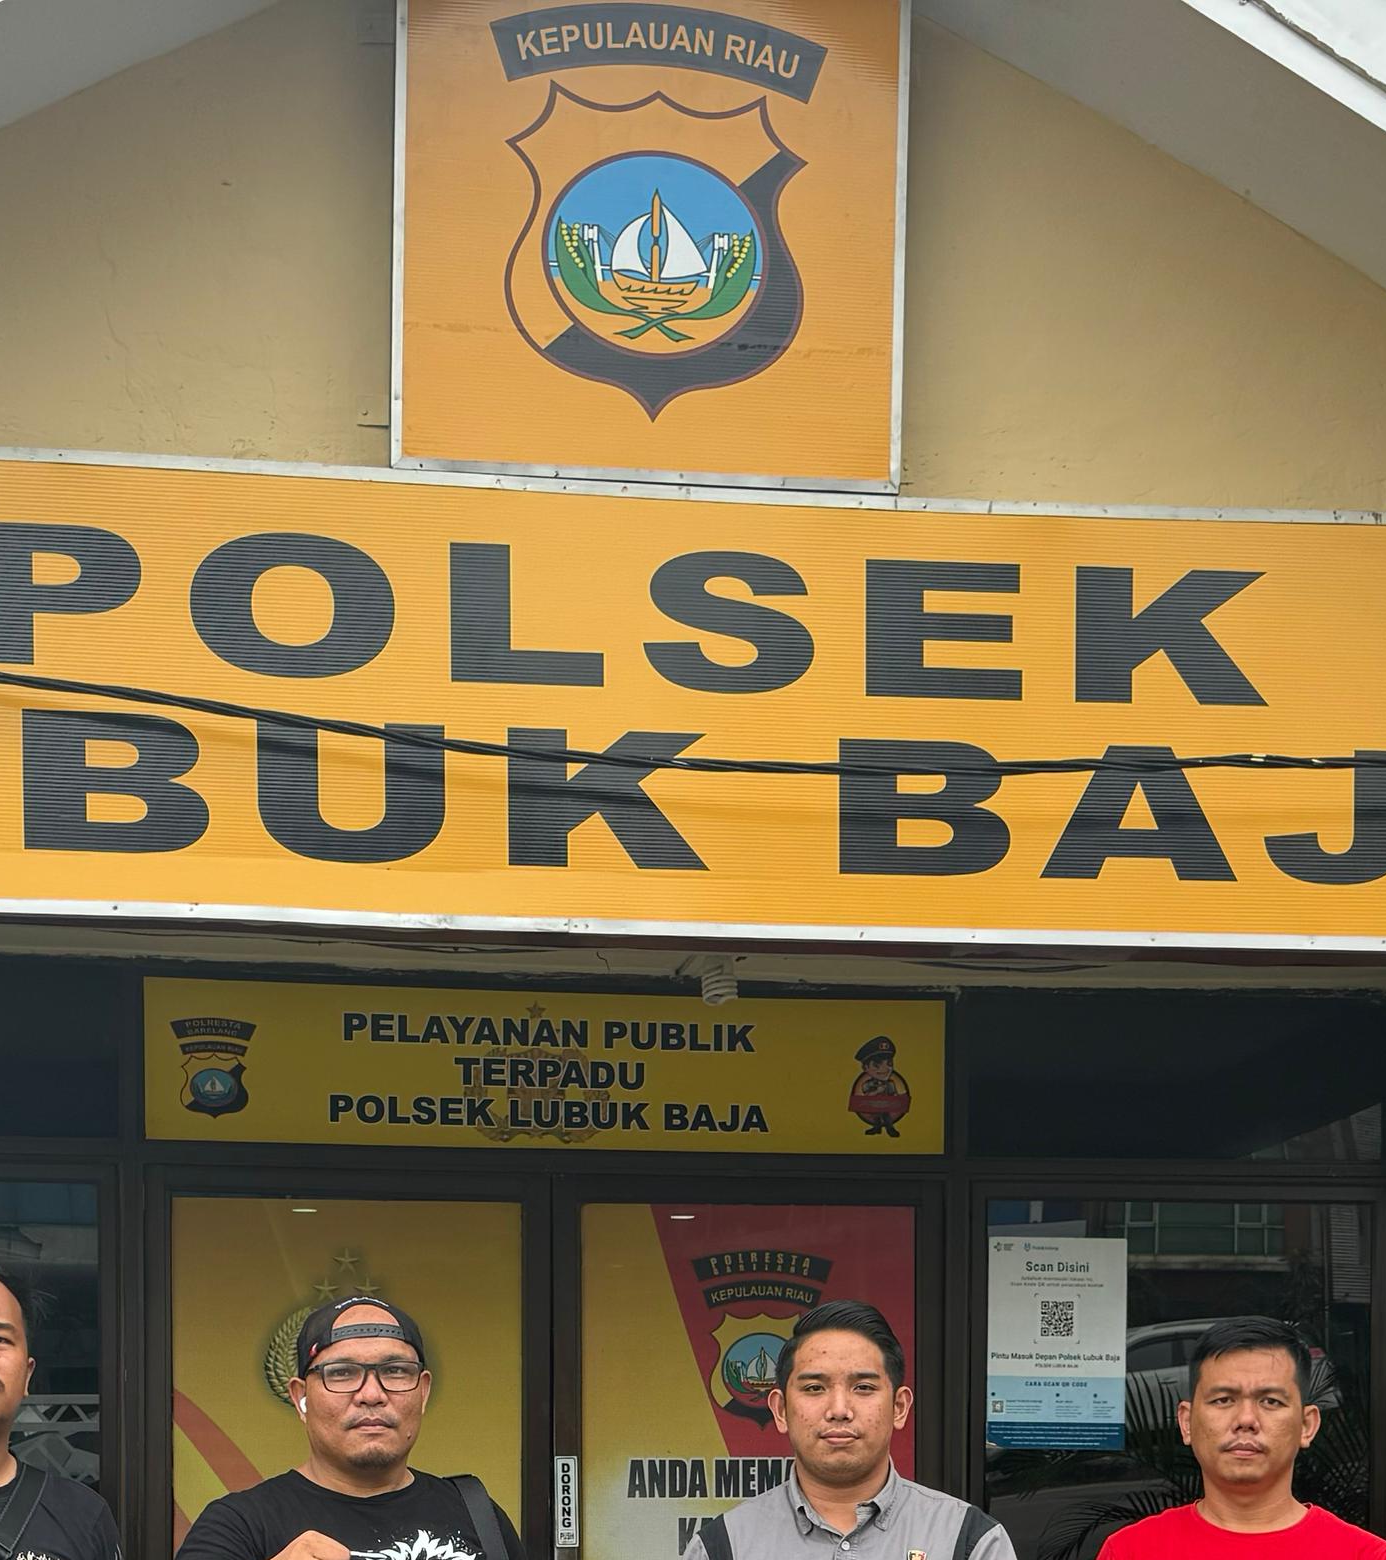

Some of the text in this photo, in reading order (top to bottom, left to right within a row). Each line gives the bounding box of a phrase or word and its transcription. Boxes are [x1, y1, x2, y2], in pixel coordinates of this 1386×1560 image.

[516, 21, 801, 80] KEPULAUAN RIAU
[343, 1012, 757, 1053] PELAYANAN PUBLIK
[454, 1056, 646, 1090] TERPADU
[328, 1094, 770, 1133] POLSEK LUBUK BAJA
[709, 1252, 811, 1270] POLRESTA
[1025, 1261, 1090, 1273] Scan Disini
[710, 1285, 814, 1303] KEPULAUAN RIAU
[990, 1352, 1010, 1360] Pintu
[1011, 1352, 1034, 1360] Masuk
[1035, 1353, 1057, 1362] Depan
[561, 1463, 572, 1528] DORONG
[627, 1459, 709, 1498] ANDA
